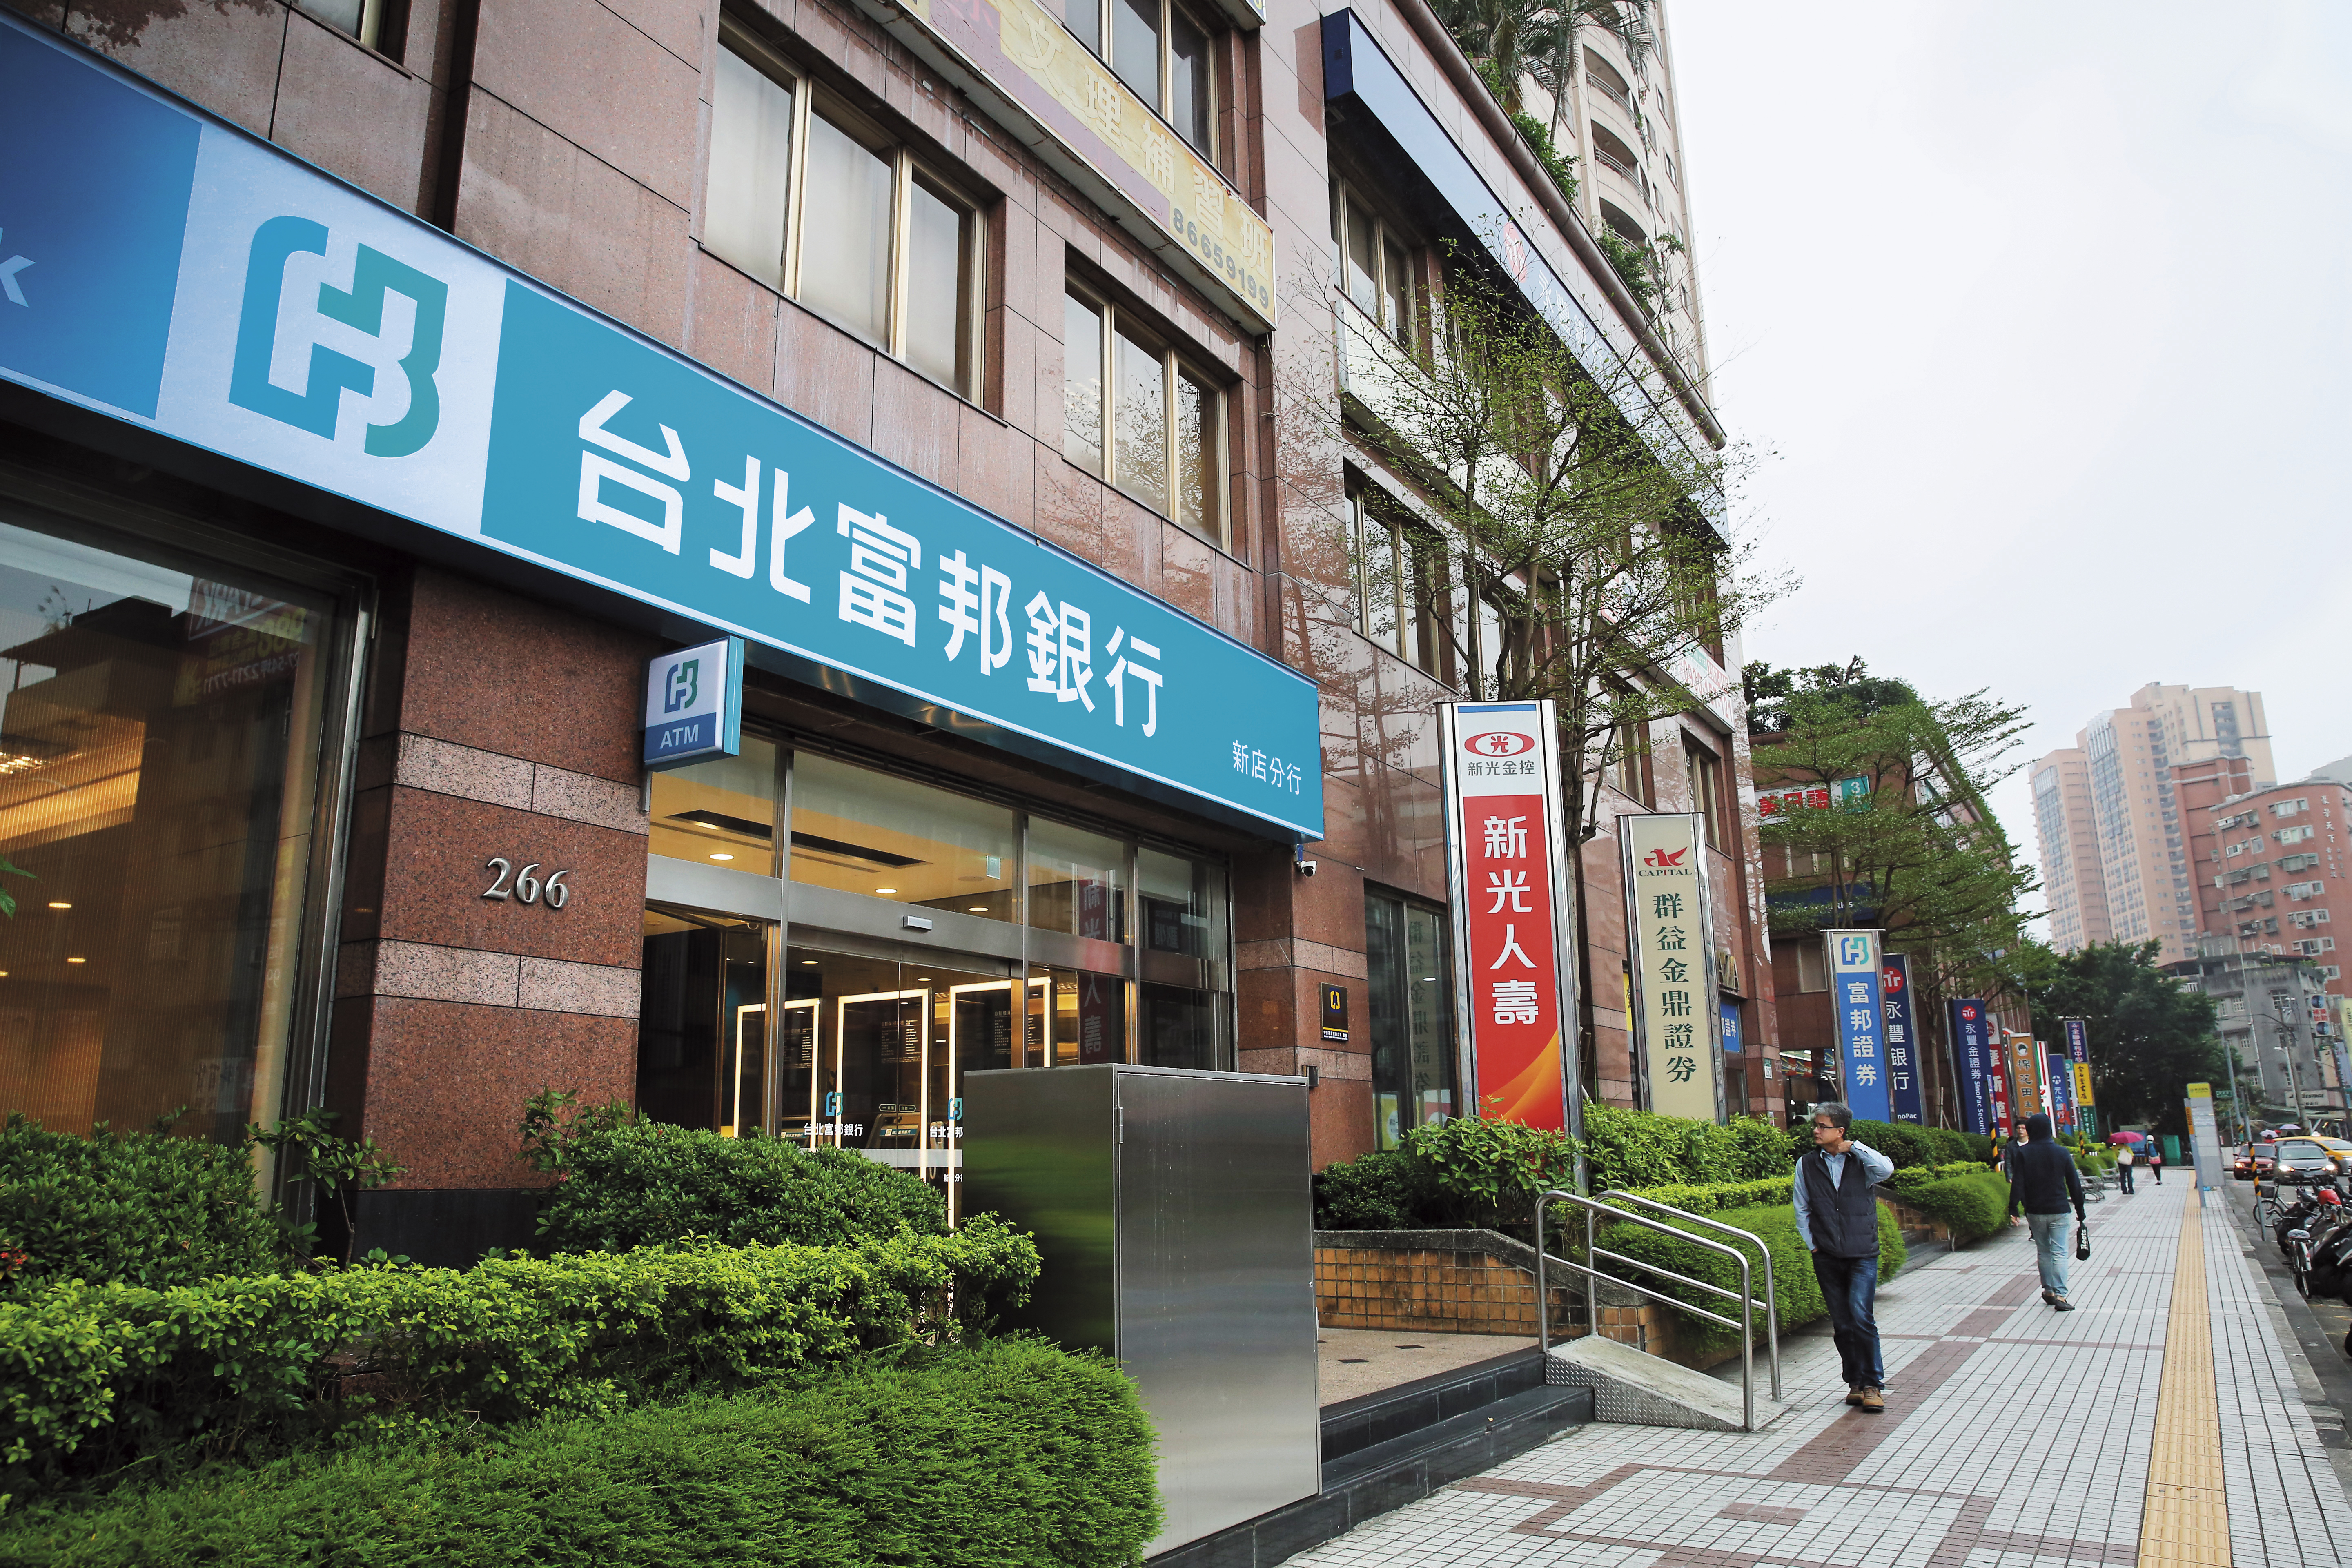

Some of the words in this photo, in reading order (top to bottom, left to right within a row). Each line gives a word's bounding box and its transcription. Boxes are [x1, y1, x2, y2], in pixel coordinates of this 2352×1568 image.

[1173, 208, 1268, 309] 86659199
[577, 389, 1164, 737] 台北富邦銀行
[659, 724, 699, 749] ATM
[1232, 739, 1301, 795] 新店分行
[1468, 760, 1535, 777] 新光金控
[481, 857, 570, 908] 266
[1638, 869, 1692, 877] CAPITAL
[1484, 815, 1540, 1025] 新光人壽
[1653, 893, 1697, 1083] 群益金鼎證券
[1847, 982, 1877, 1087] 富邦證券
[1885, 1000, 1909, 1091] 永豐銀行
[1965, 1023, 1982, 1079] 永豐金證券
[1974, 1081, 1982, 1107] SinoPac
[804, 1123, 863, 1136] 台北富邦銀行
[930, 1125, 963, 1138] 台北富邦
